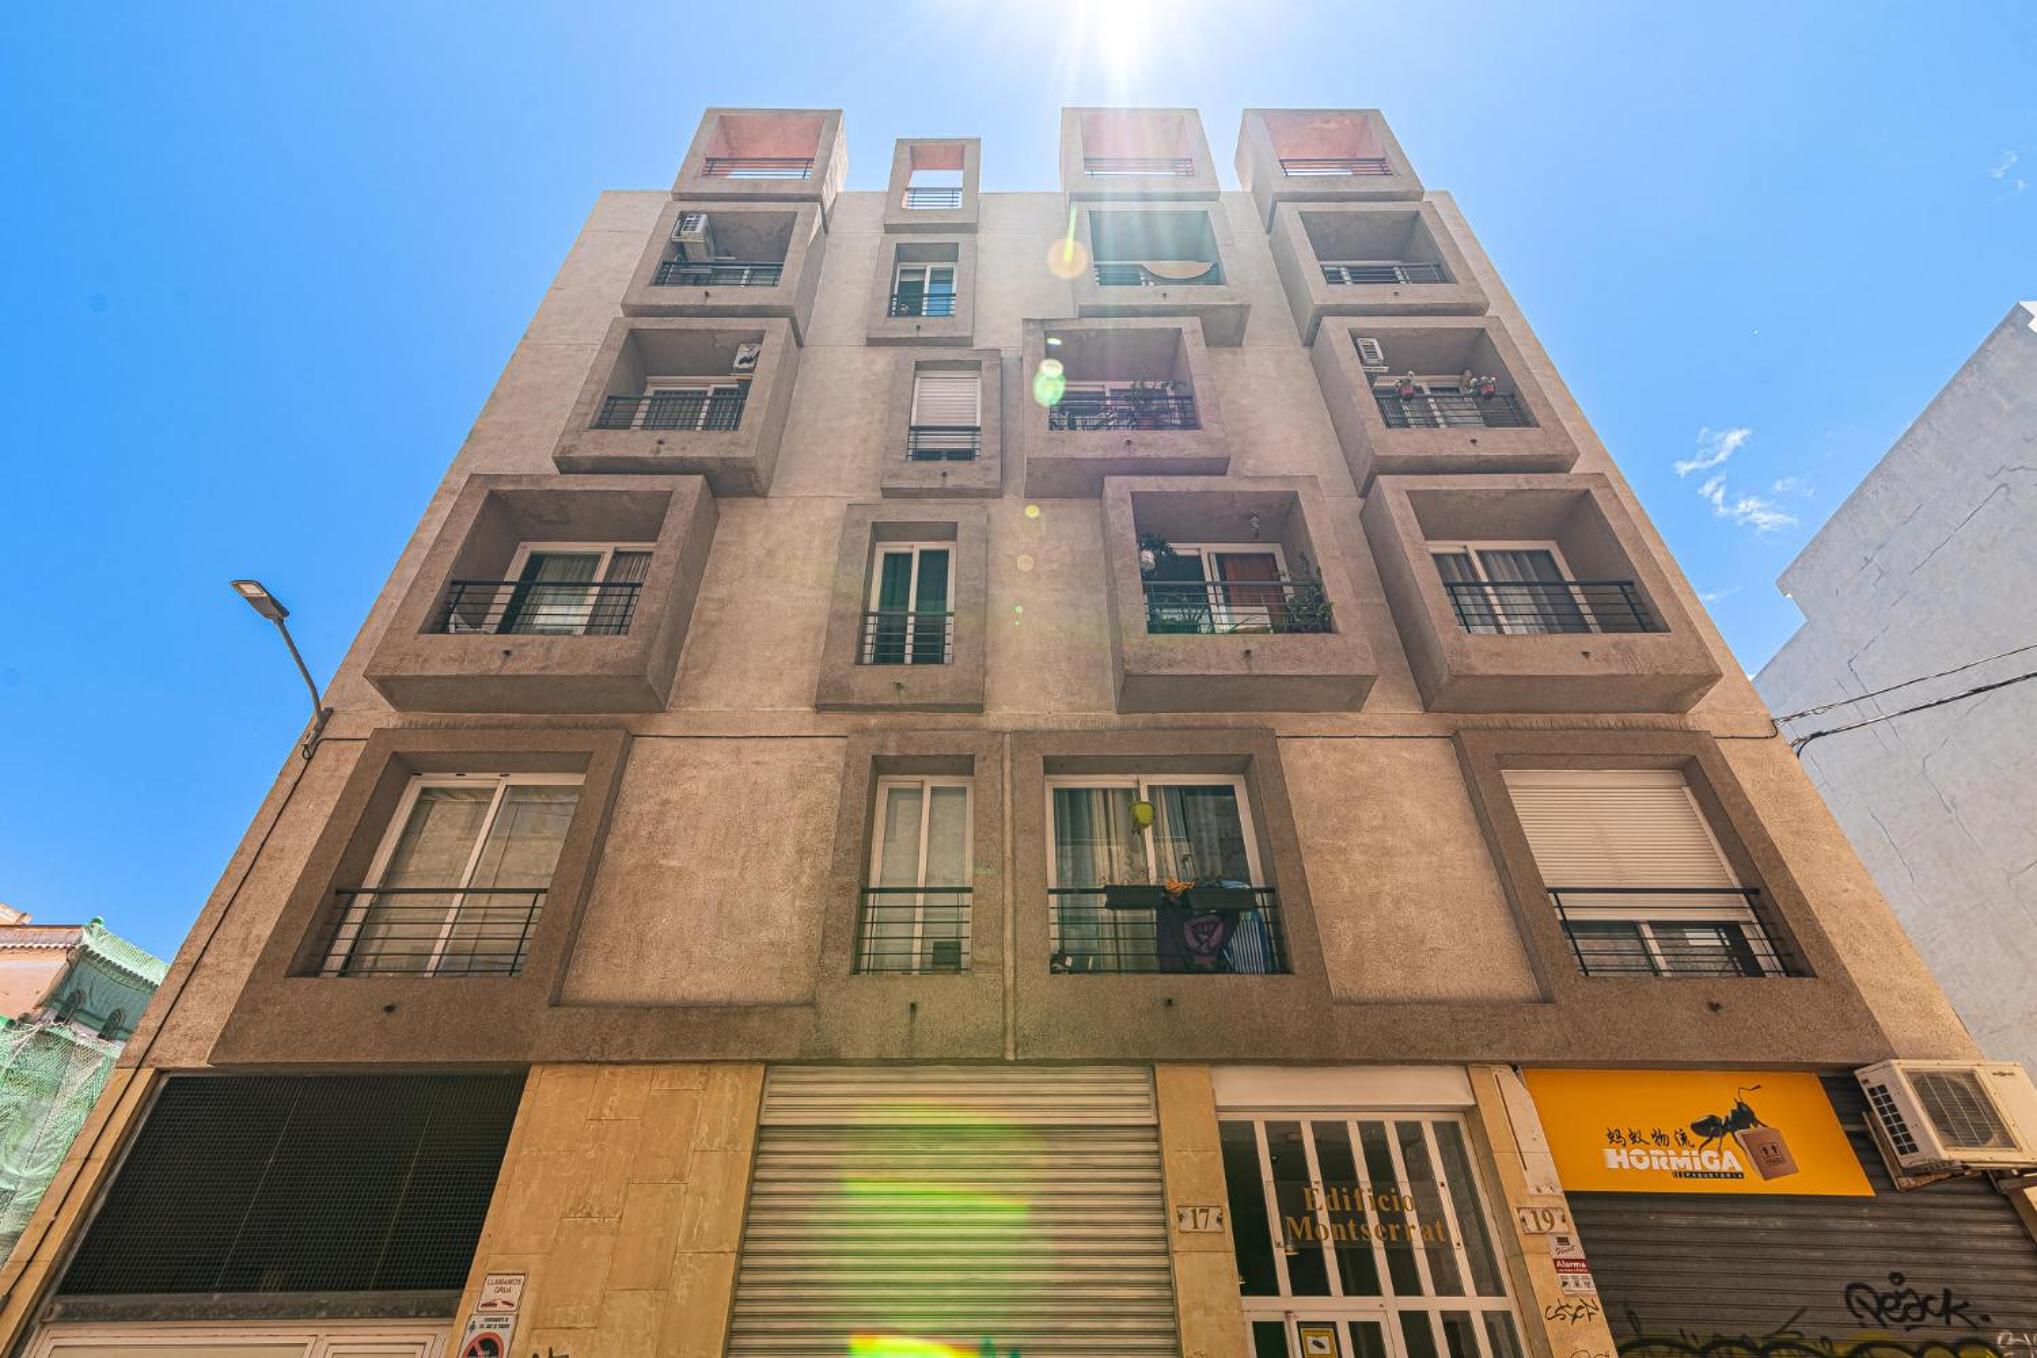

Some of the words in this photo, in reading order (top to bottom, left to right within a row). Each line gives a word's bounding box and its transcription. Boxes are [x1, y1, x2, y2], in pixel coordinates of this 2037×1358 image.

[1606, 1127, 1695, 1147] 蚂蚁物流
[1303, 1186, 1415, 1212] Edificio
[1190, 1208, 1210, 1230] 17
[1286, 1216, 1446, 1242] Montserrat
[1531, 1209, 1555, 1231] 19
